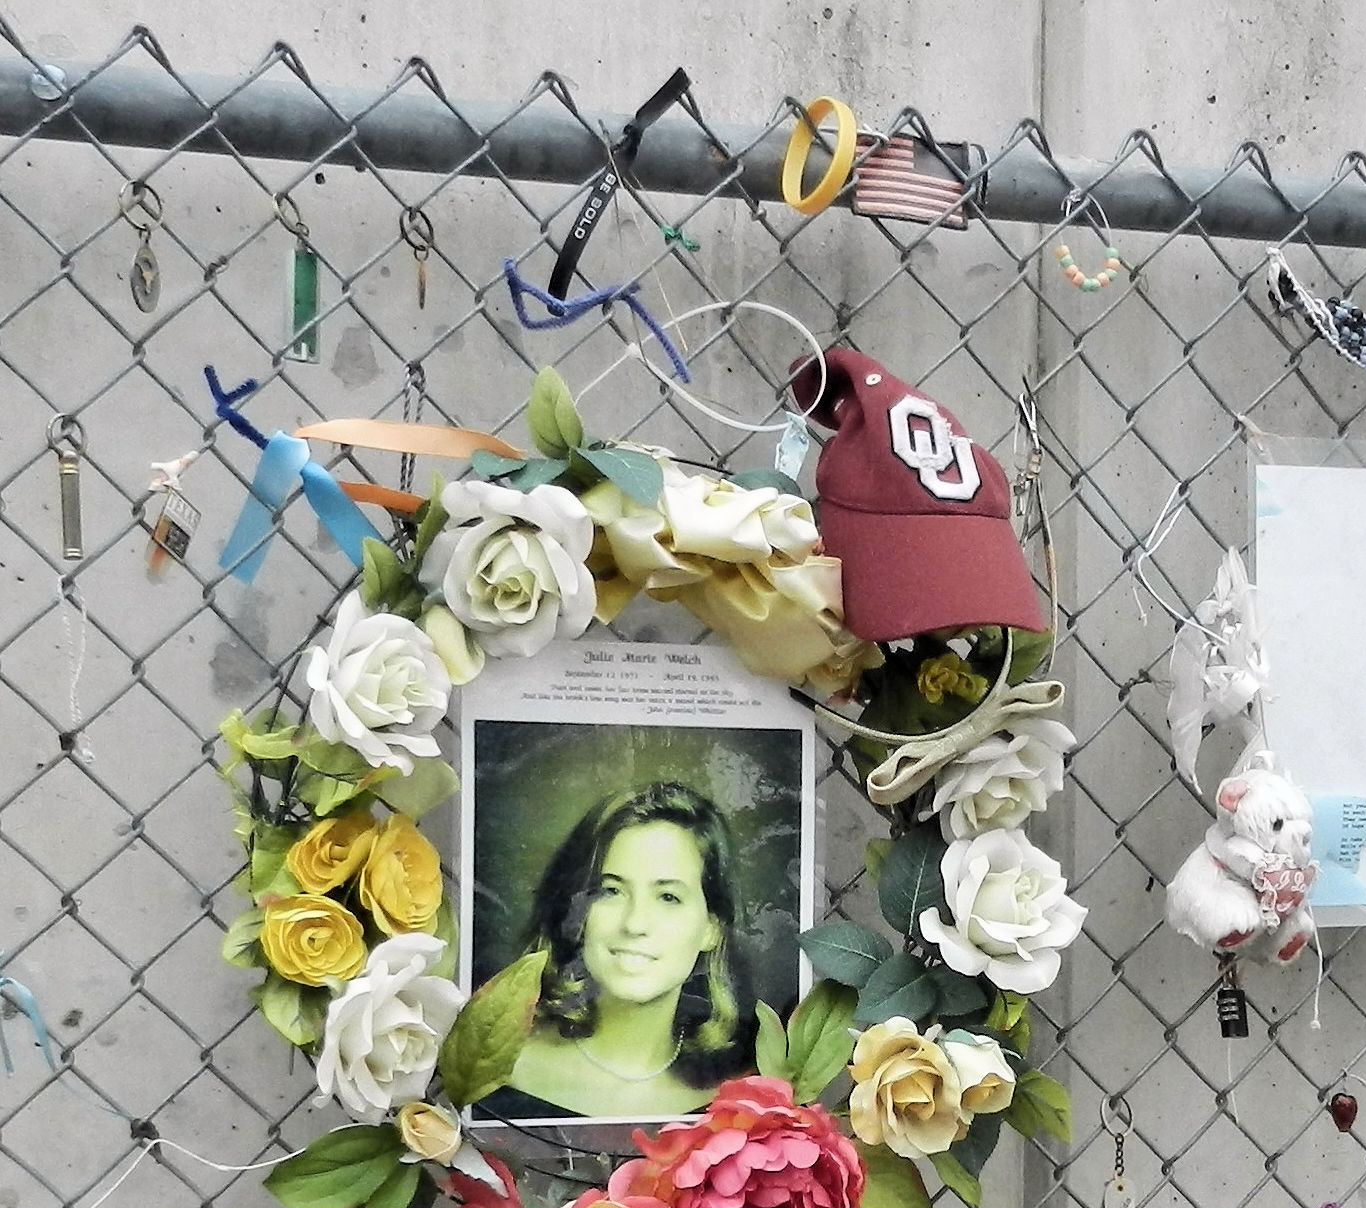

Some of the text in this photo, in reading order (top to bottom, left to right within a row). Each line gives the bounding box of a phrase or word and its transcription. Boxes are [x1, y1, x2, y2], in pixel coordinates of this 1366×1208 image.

[574, 173, 617, 239] BE BOLD
[888, 395, 982, 502] OU
[584, 650, 702, 665] Julie Marie Welch
